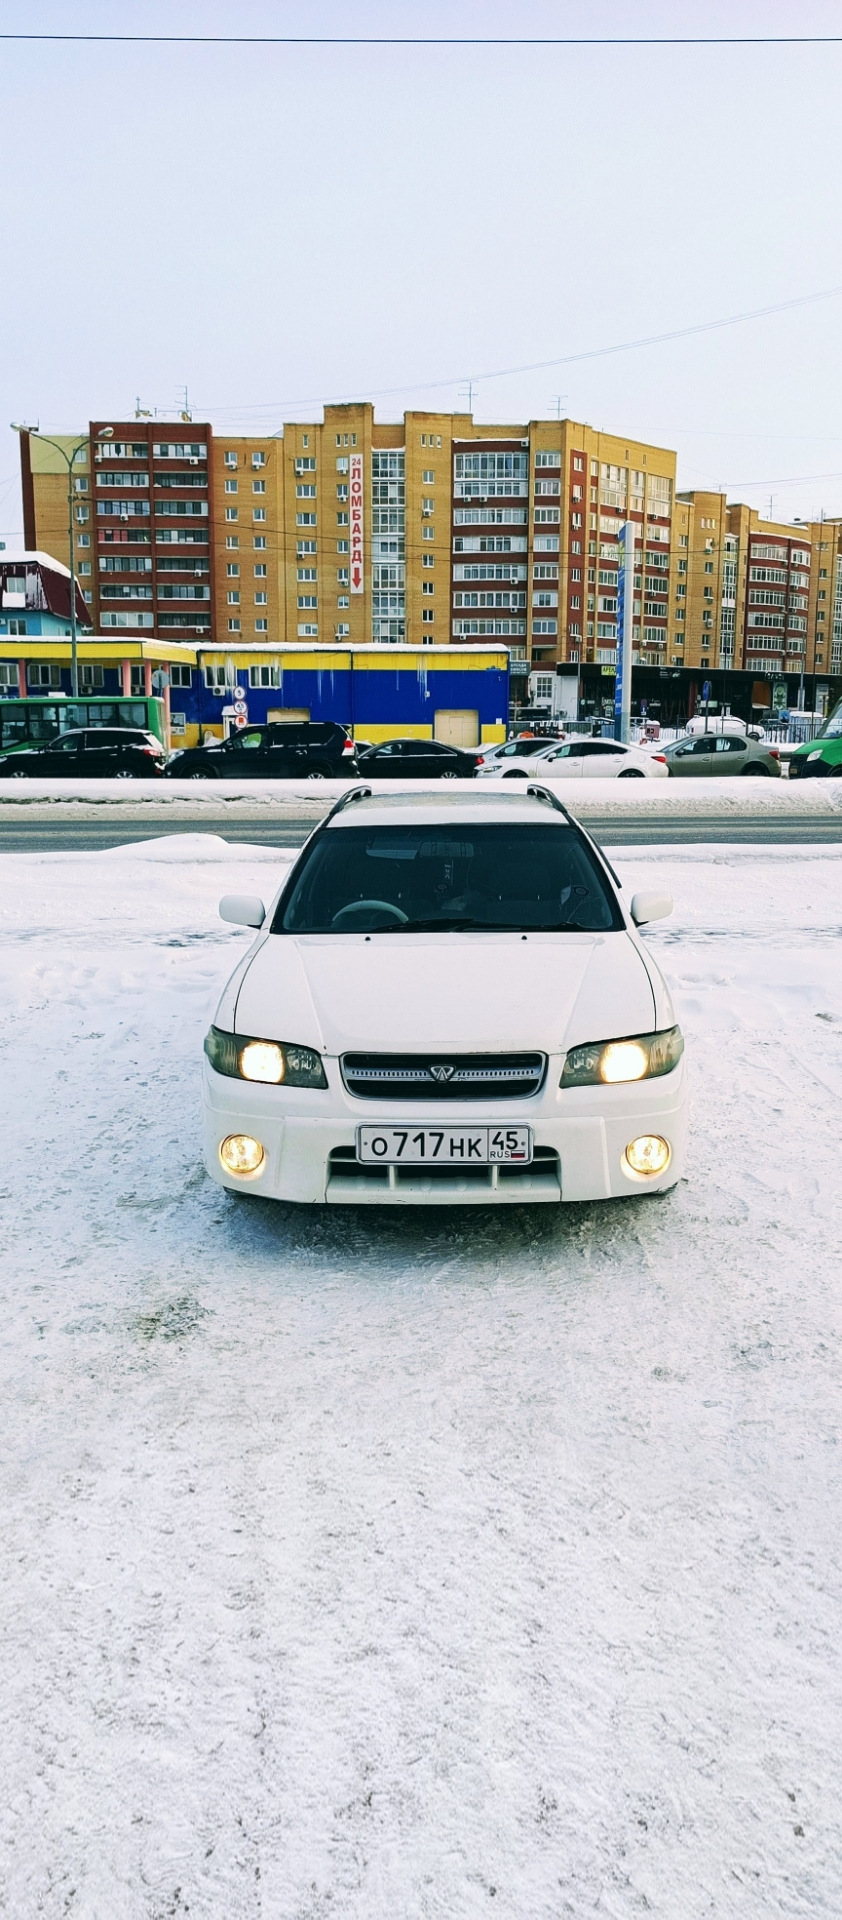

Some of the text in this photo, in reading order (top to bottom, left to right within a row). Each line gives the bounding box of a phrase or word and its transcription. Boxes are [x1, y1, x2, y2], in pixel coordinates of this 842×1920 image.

[351, 468, 362, 564] ЛОМБАРД
[492, 1131, 519, 1151] 45
[490, 1150, 511, 1158] RUS
